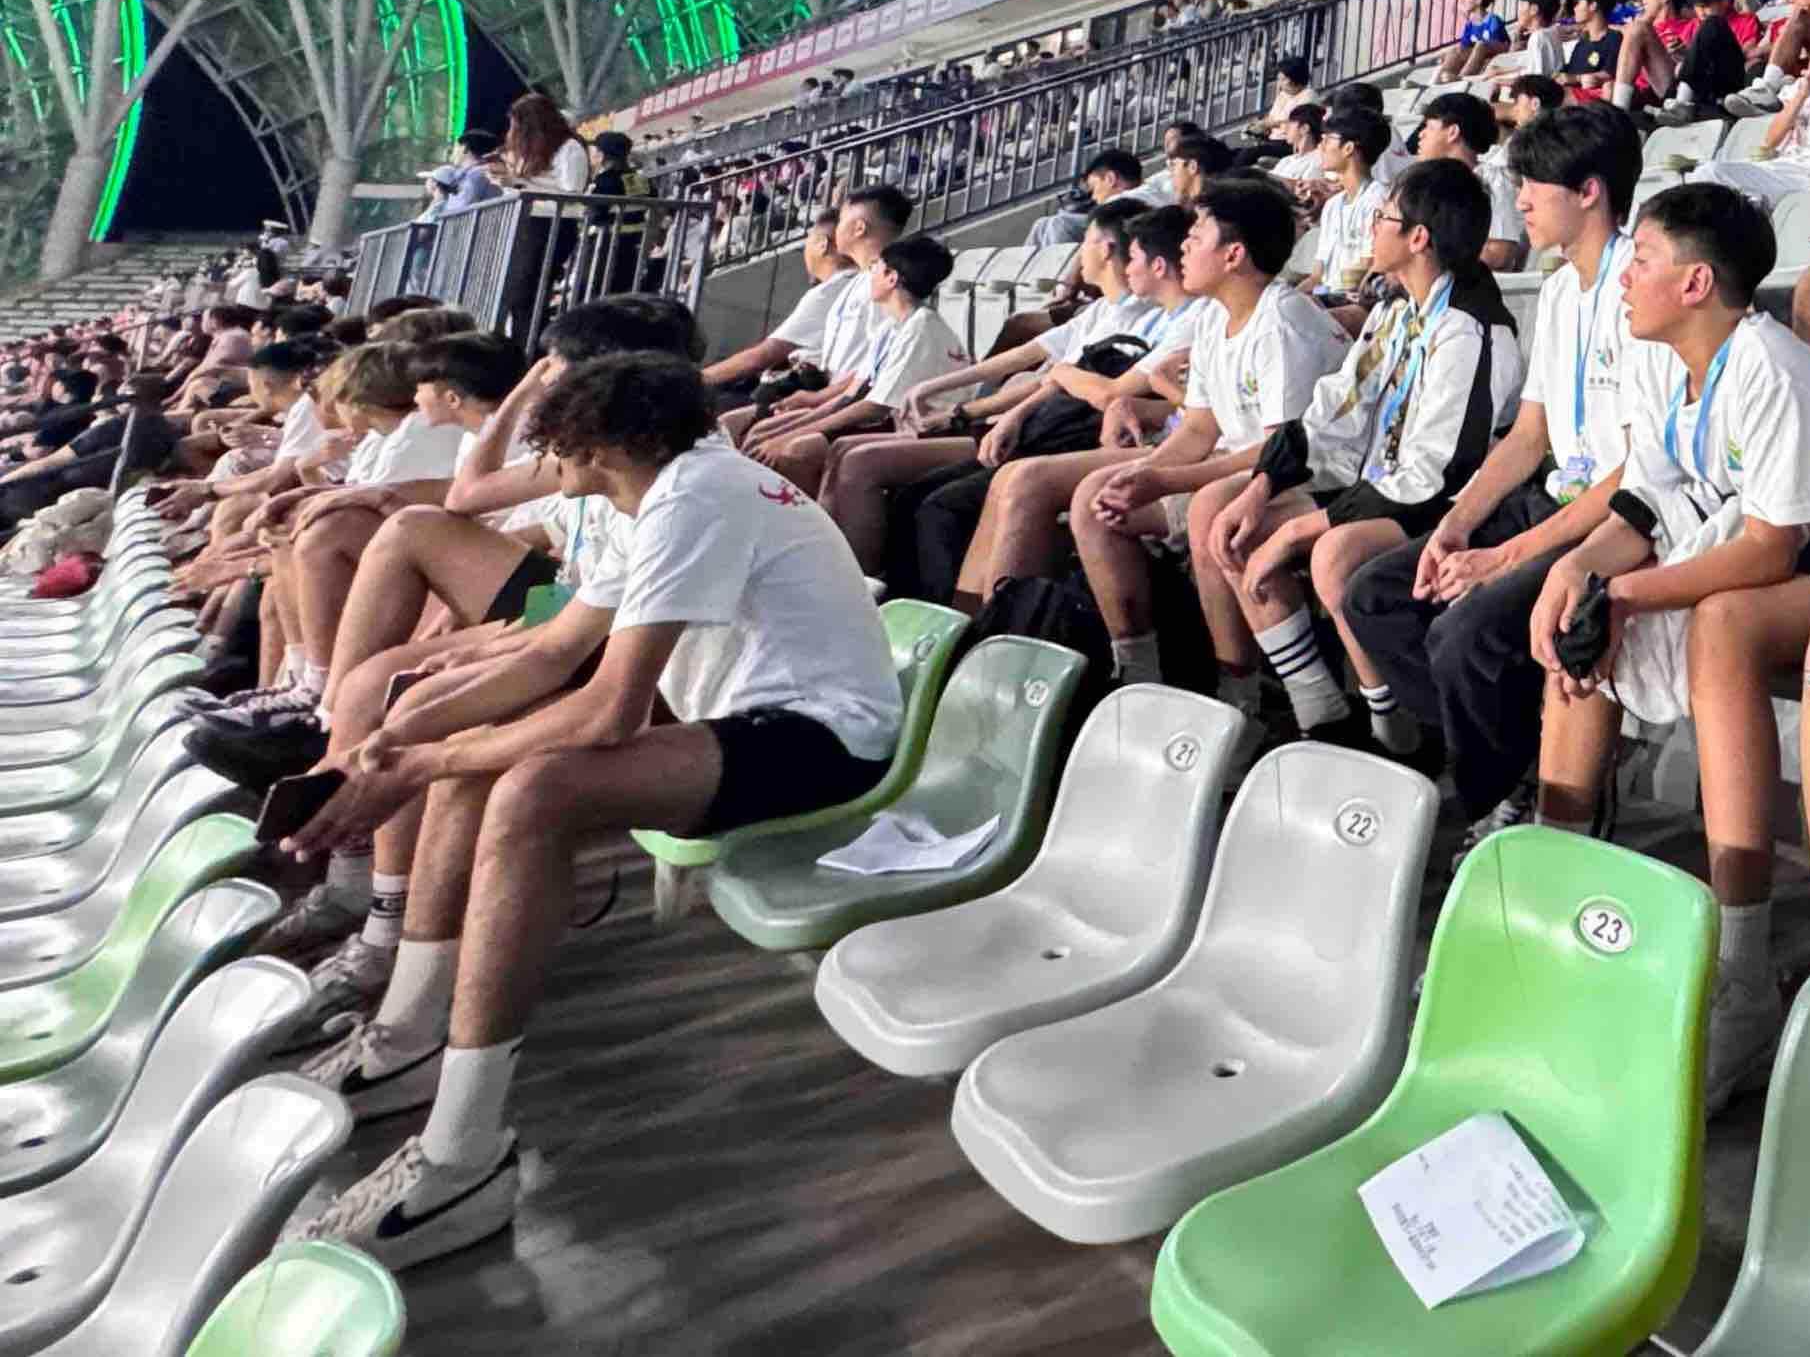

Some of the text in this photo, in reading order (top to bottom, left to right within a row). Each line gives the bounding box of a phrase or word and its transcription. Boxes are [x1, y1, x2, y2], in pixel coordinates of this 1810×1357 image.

[1175, 742, 1195, 764] 21
[1347, 812, 1372, 839] 22
[1593, 912, 1624, 946] 23
